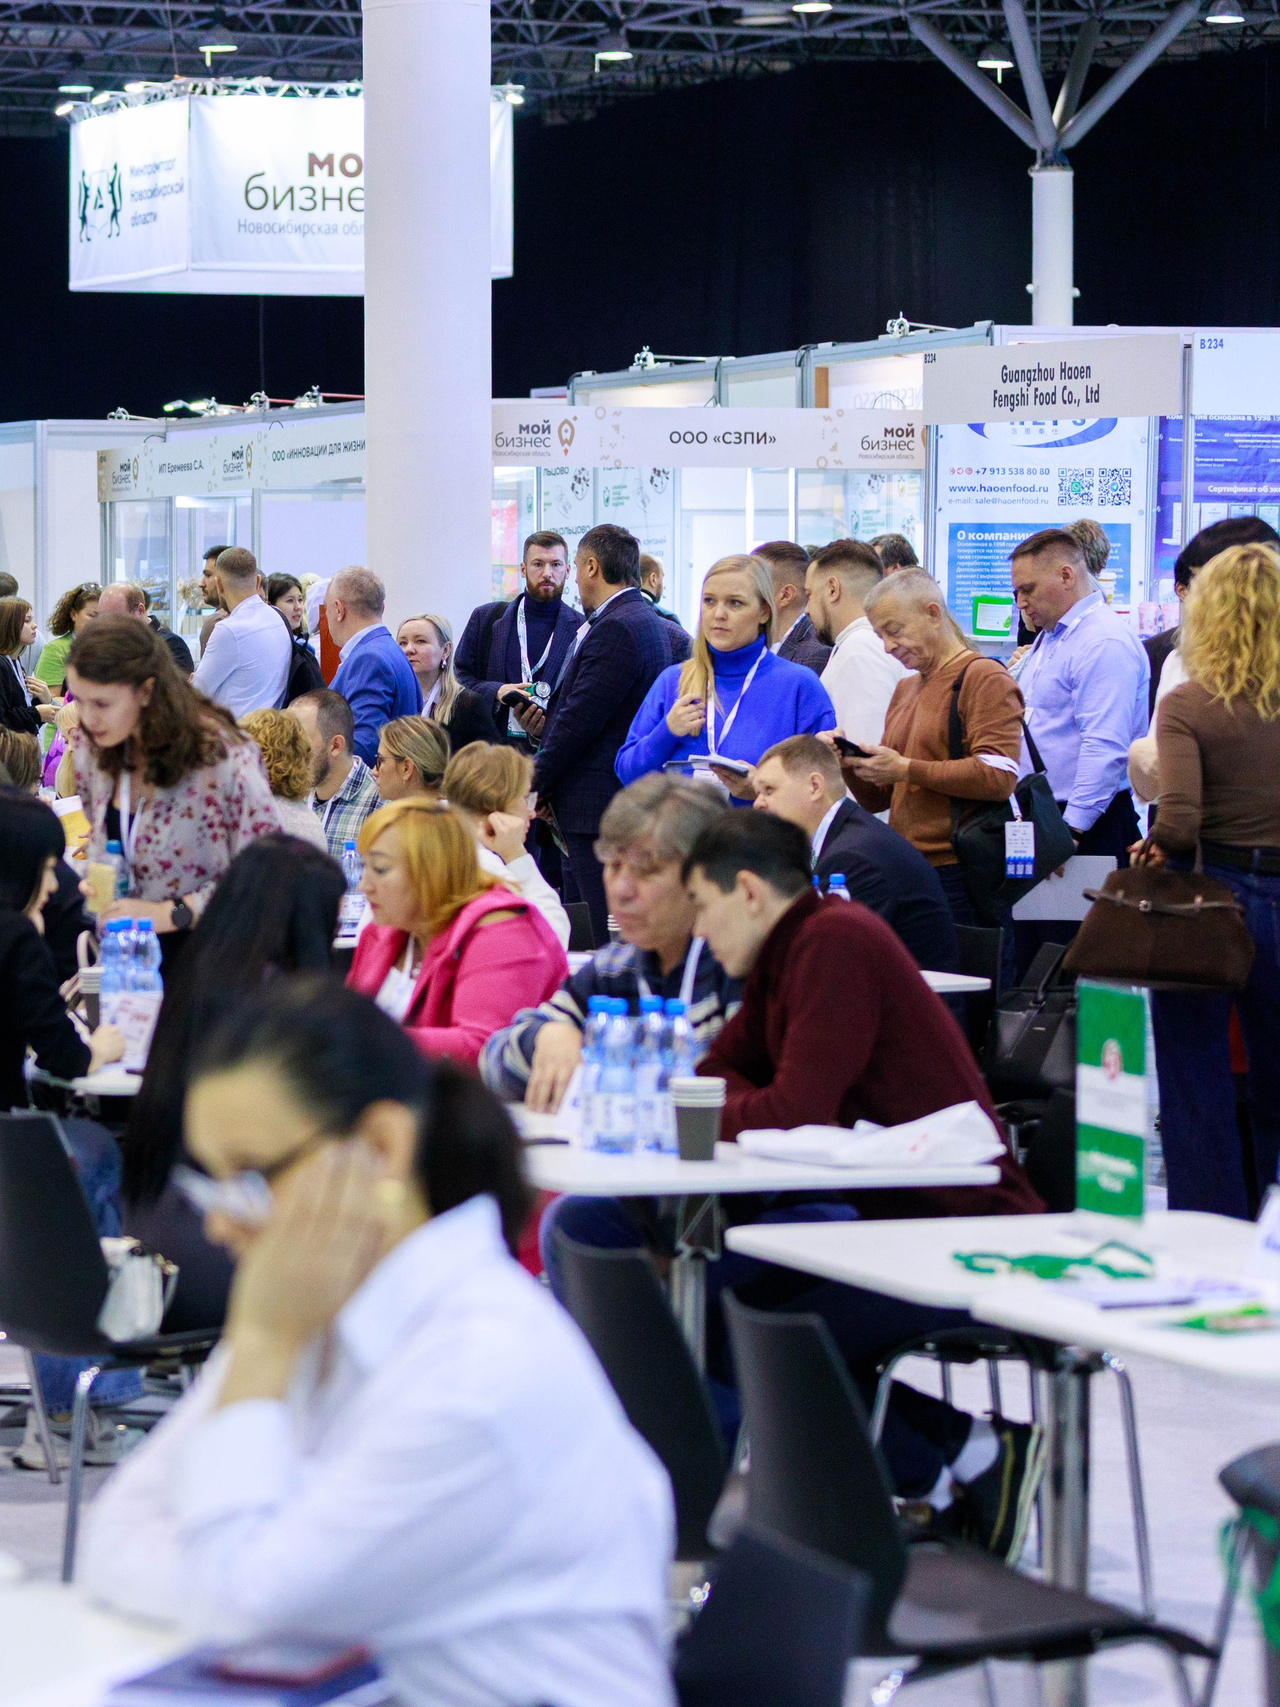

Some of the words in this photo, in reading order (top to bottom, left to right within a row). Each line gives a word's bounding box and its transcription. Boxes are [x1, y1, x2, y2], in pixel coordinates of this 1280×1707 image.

[308, 152, 363, 178] мо
[245, 171, 364, 212] бизне
[238, 218, 338, 238] Новосибирская
[342, 219, 364, 235] обл
[1001, 362, 1055, 388] Guangzhou
[1059, 361, 1091, 380] Haoen
[993, 387, 1029, 412] Fengshi
[1033, 385, 1057, 406] Food
[1061, 385, 1081, 407] Co.,
[1085, 383, 1100, 404] Ltd
[518, 419, 551, 434] мой
[883, 423, 915, 437] мой
[494, 432, 551, 448] бизнес
[669, 431, 708, 444] ООО
[713, 431, 776, 445] «СЗПИ»
[861, 435, 915, 451] бизнес
[231, 445, 243, 460] мой
[272, 450, 285, 461] ООО
[328, 442, 341, 456] ДЛЯ
[120, 458, 131, 472] мой
[158, 463, 167, 474] ИП
[223, 459, 243, 473] бизнес
[975, 467, 987, 475] +7
[989, 467, 1006, 475] 913
[1008, 467, 1024, 475] 538
[1026, 467, 1037, 475] 80
[1039, 467, 1050, 475] 80
[948, 484, 1049, 493] www.haoenfood.ru
[1207, 485, 1256, 494] Сертификат
[974, 497, 1049, 505] sale@haoenfood.ru
[956, 530, 966, 541] О
